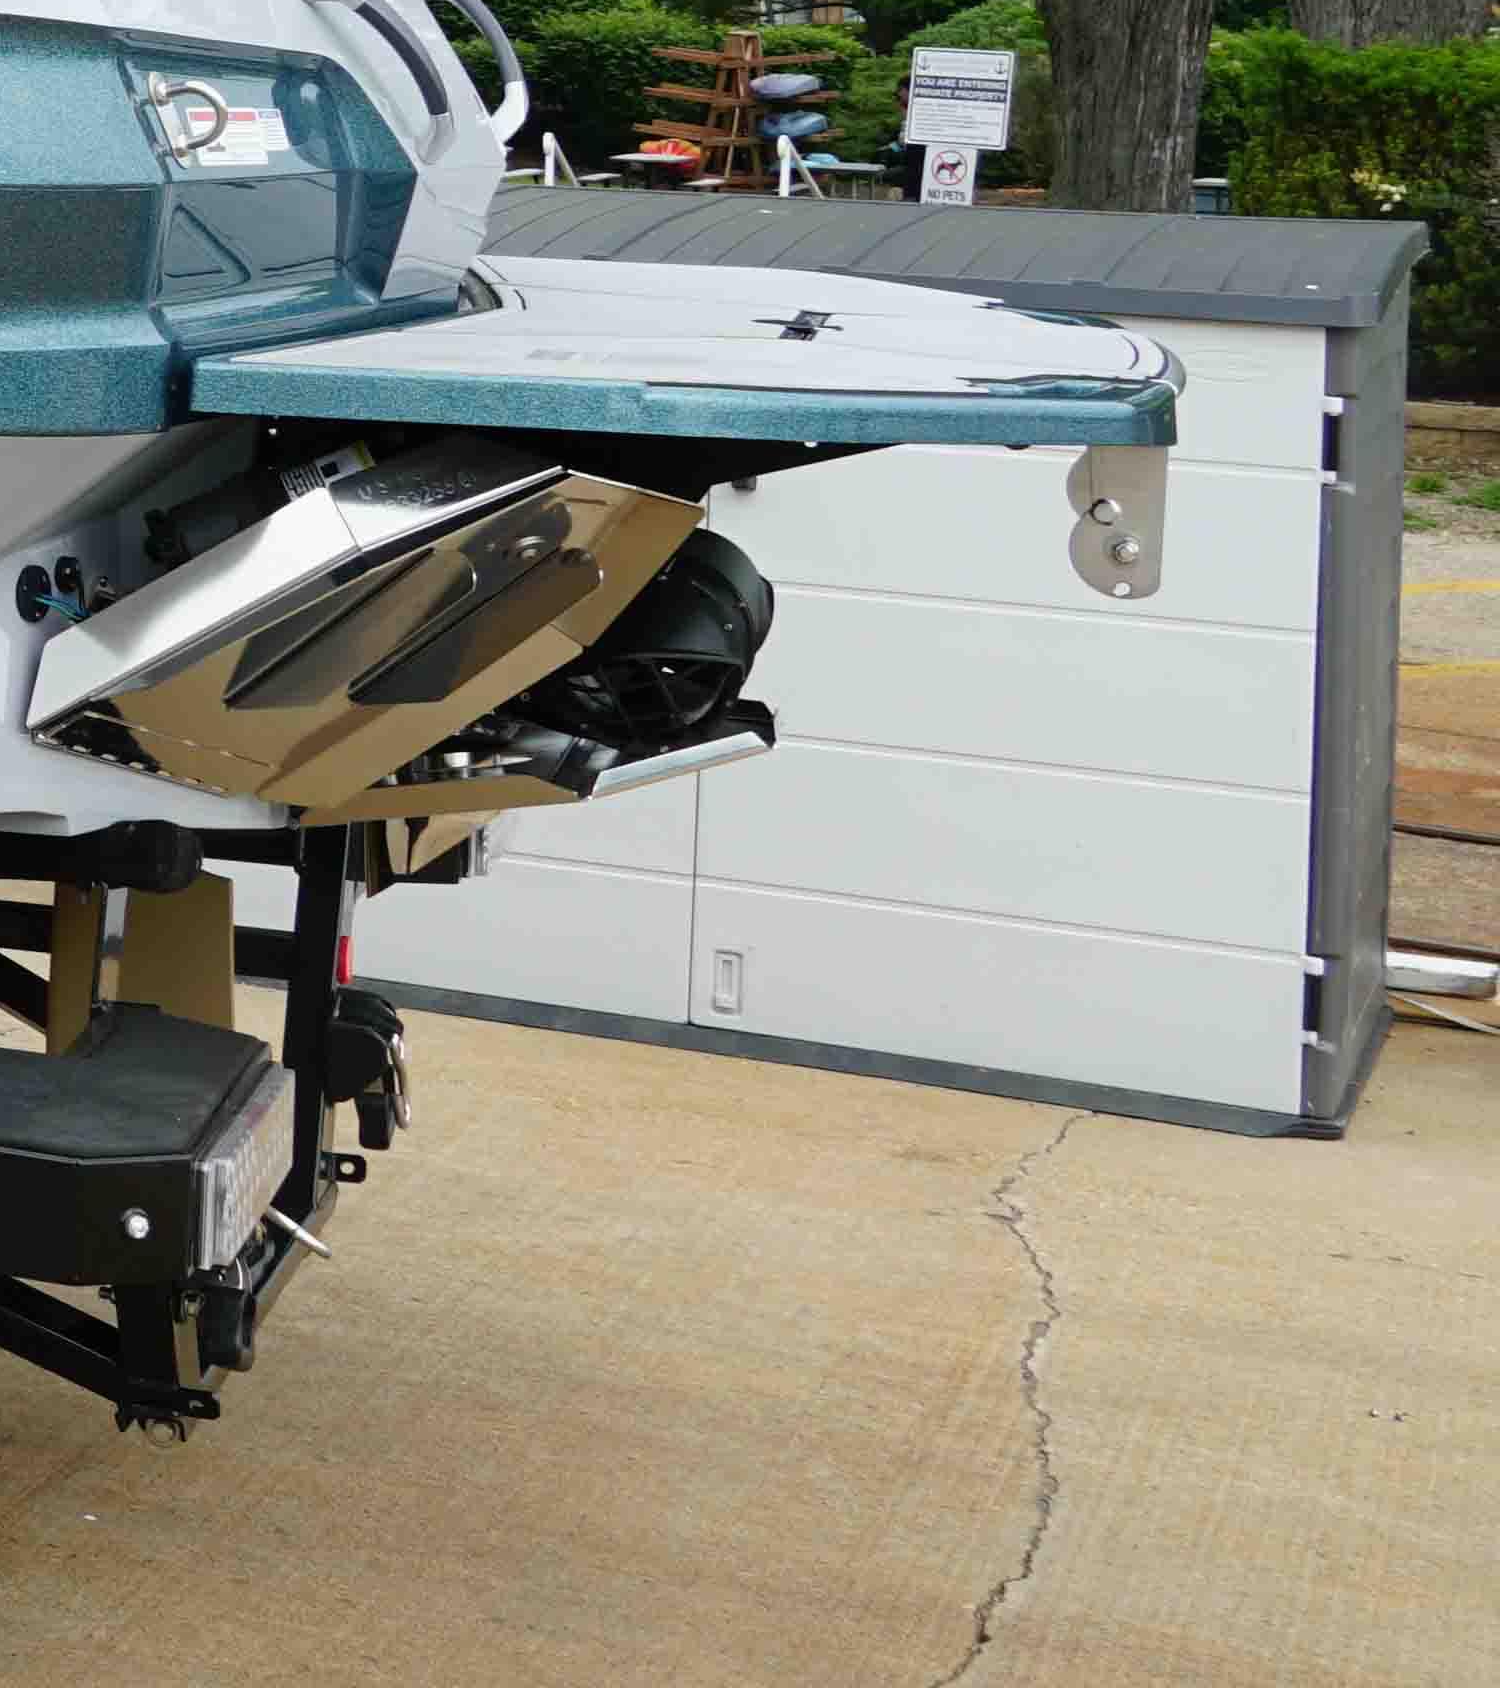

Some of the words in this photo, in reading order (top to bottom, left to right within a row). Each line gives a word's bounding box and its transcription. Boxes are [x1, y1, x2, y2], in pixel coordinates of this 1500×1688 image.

[915, 76, 935, 88] YOU
[936, 77, 956, 89] ARE
[927, 188, 940, 199] NO
[942, 190, 966, 202] PETS
